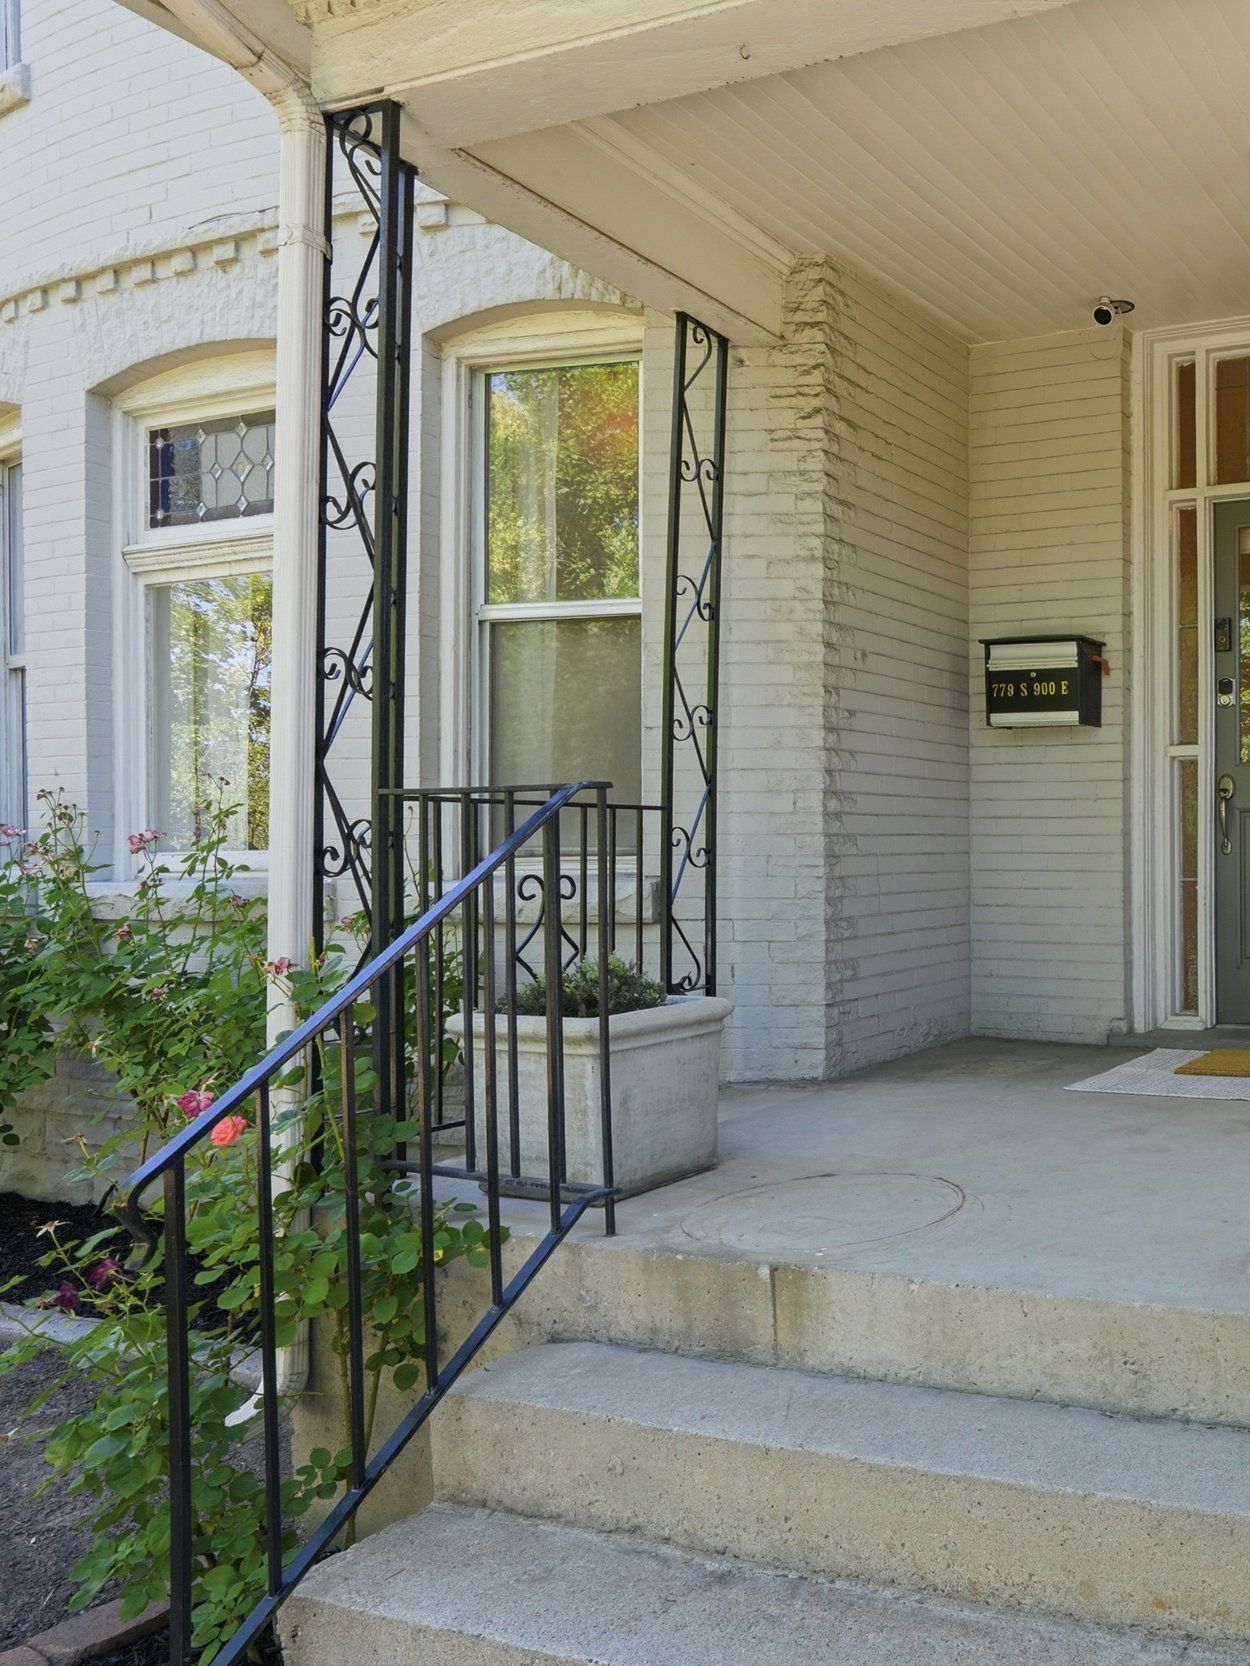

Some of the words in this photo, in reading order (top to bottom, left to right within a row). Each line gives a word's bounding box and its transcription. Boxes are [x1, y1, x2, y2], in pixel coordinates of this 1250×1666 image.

[992, 683, 1014, 696] 779
[1020, 683, 1028, 696] S
[1033, 682, 1056, 696] 900
[1061, 681, 1068, 694] E
